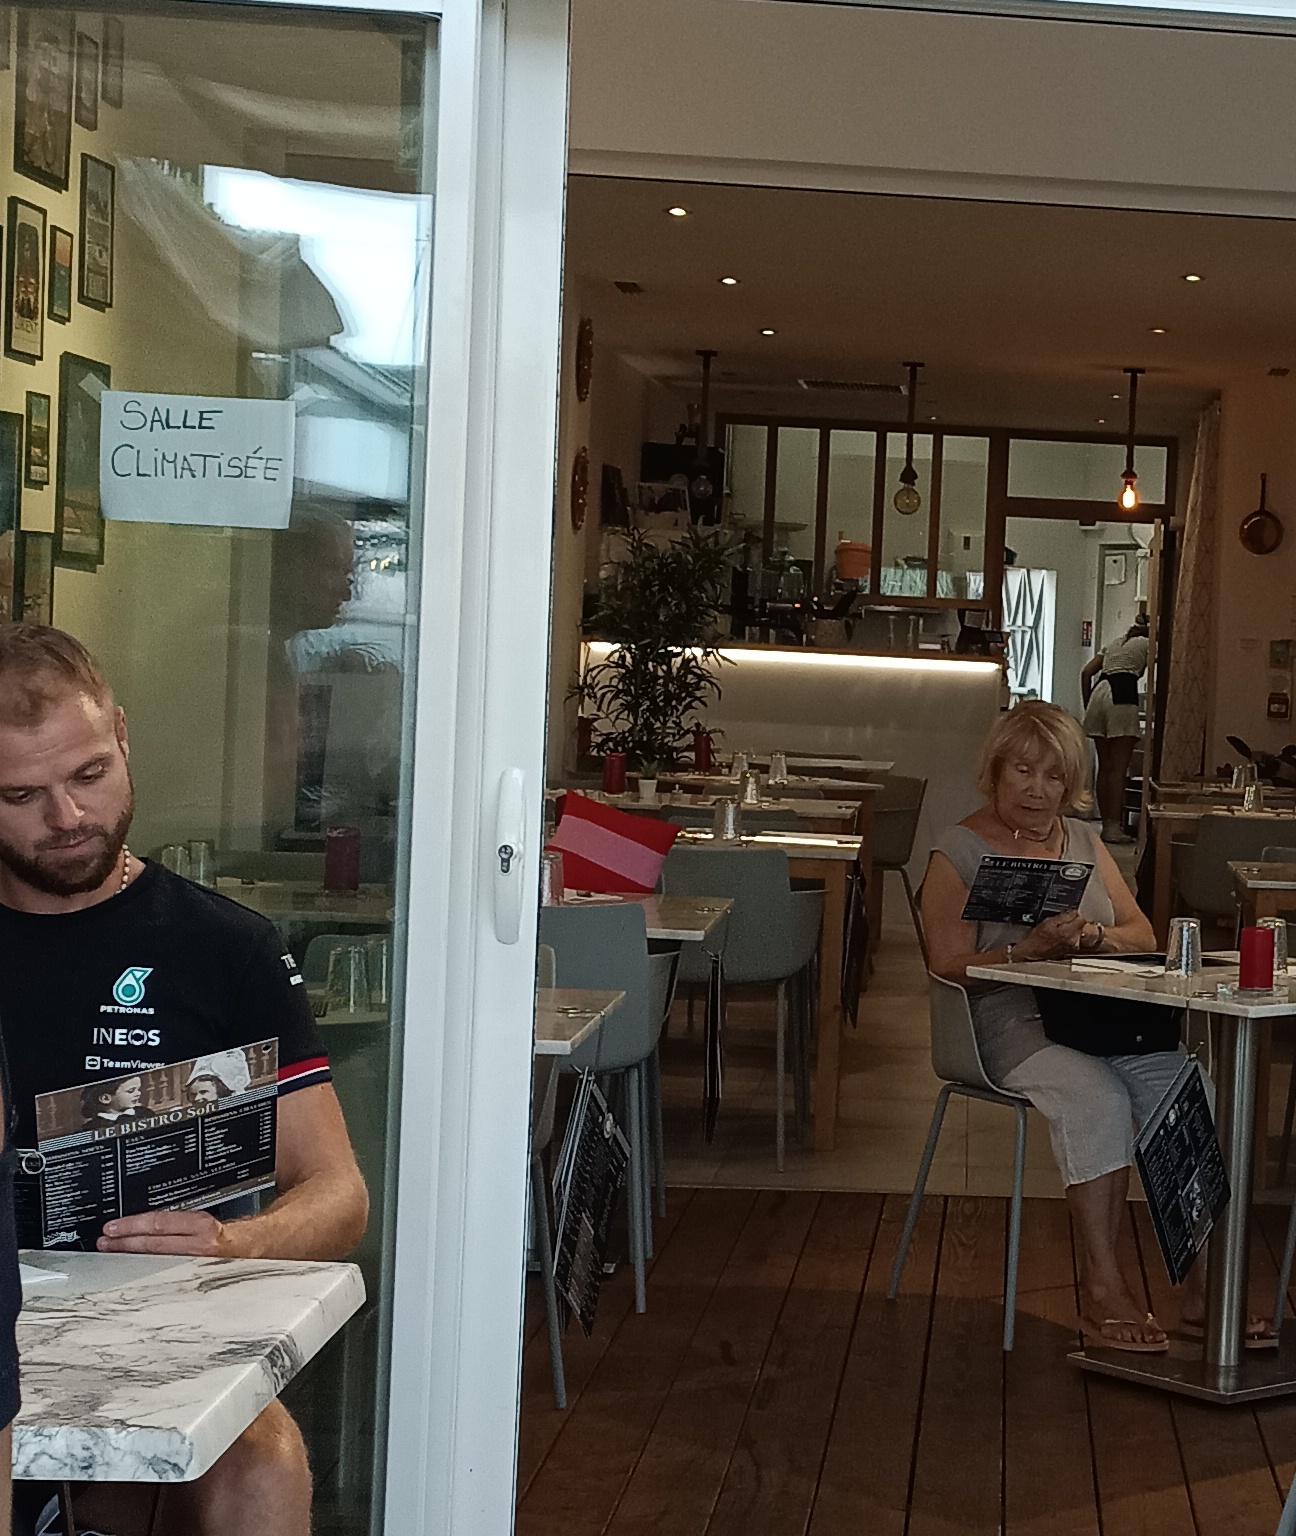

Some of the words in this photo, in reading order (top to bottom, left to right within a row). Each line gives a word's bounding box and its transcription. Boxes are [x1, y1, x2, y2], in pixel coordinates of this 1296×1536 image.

[119, 400, 224, 432] SALLE
[100, 1005, 155, 1015] PETRONAS
[92, 1027, 161, 1046] INEOS
[94, 1127, 116, 1141] LE
[120, 1111, 182, 1135] BISTRO
[187, 1102, 216, 1118] Soft
